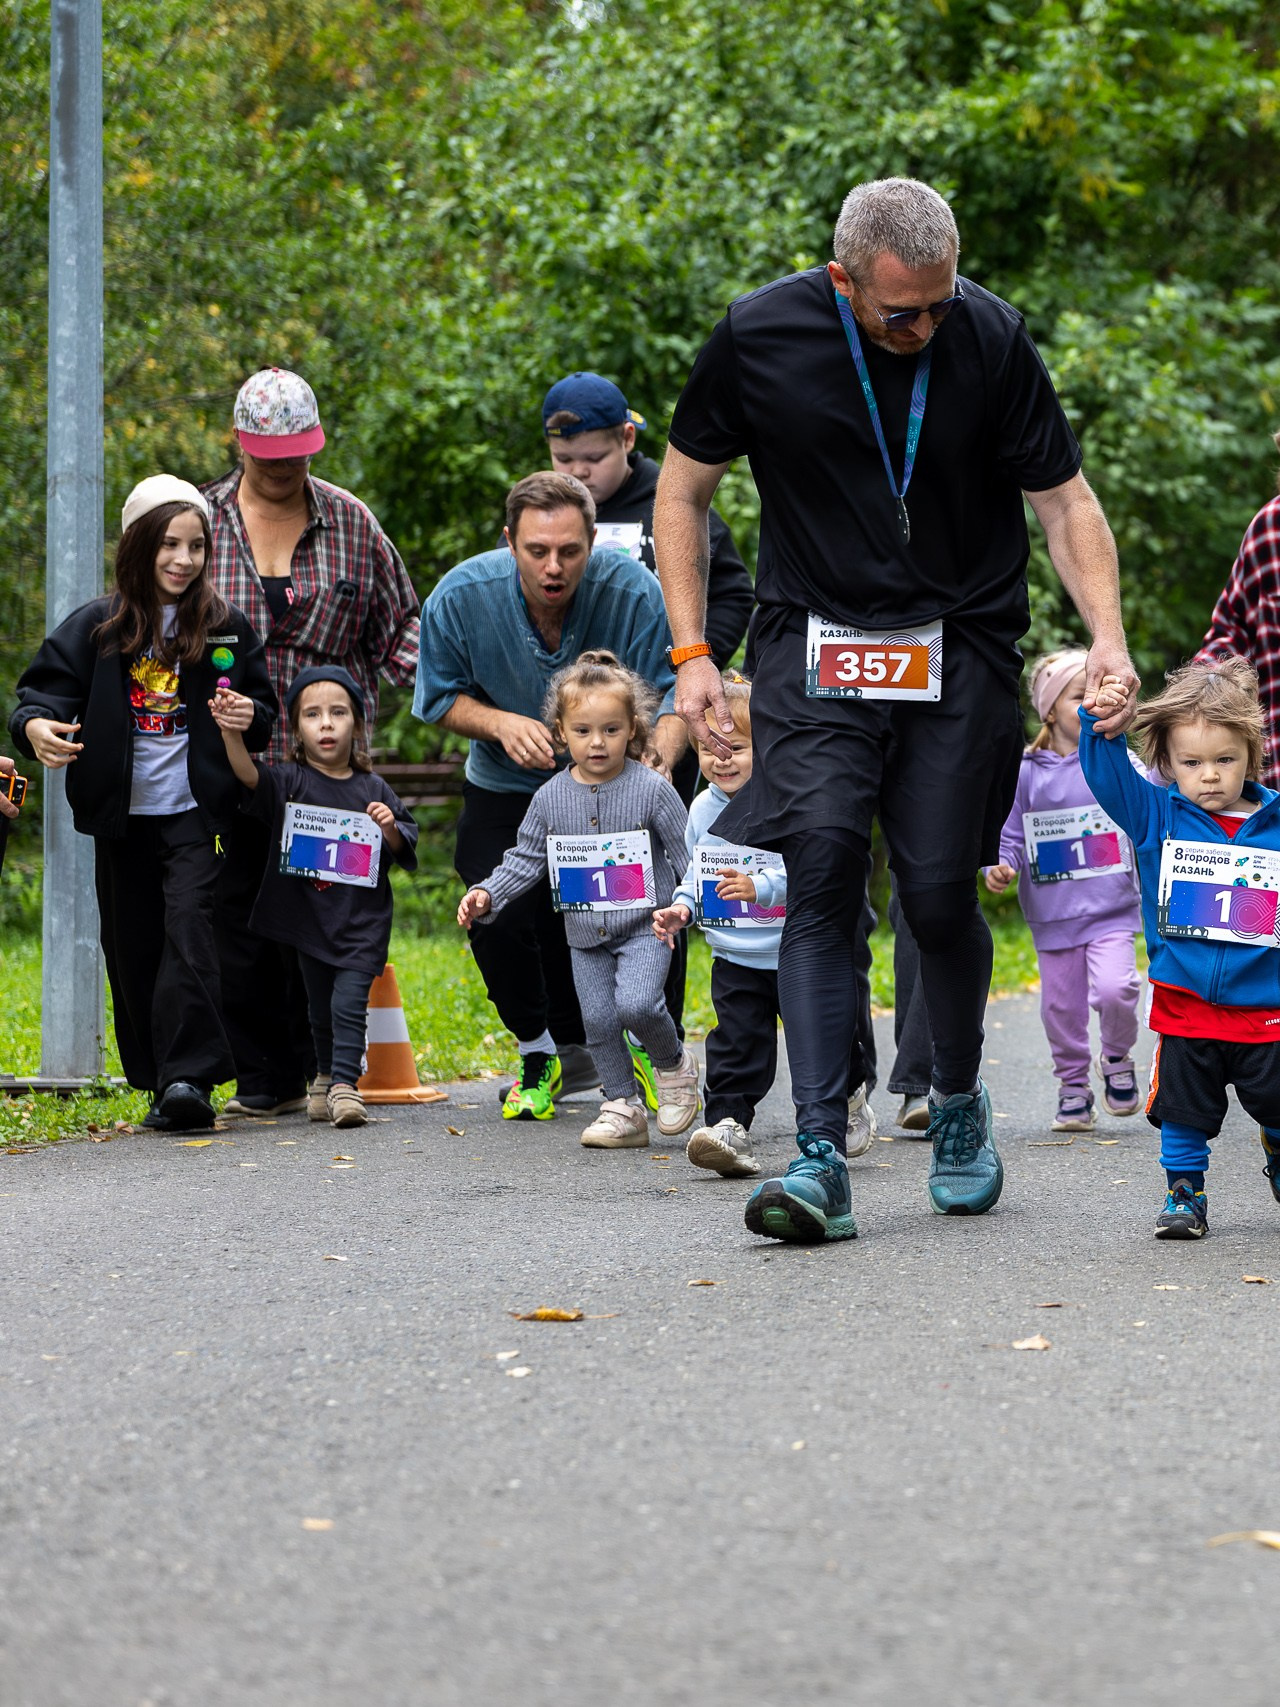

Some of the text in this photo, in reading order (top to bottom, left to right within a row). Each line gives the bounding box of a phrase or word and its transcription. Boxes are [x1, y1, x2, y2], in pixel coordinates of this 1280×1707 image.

[820, 630, 863, 638] КАЗАНЬ
[836, 652, 912, 682] 357
[293, 822, 326, 832] КАЗАНЬ
[1034, 829, 1066, 837] КАЗАНЬ
[325, 842, 338, 868] 1
[1070, 840, 1086, 866] 1
[1173, 865, 1214, 876] КАЗАНЬ
[592, 871, 607, 897] 1
[1215, 890, 1232, 923] 1
